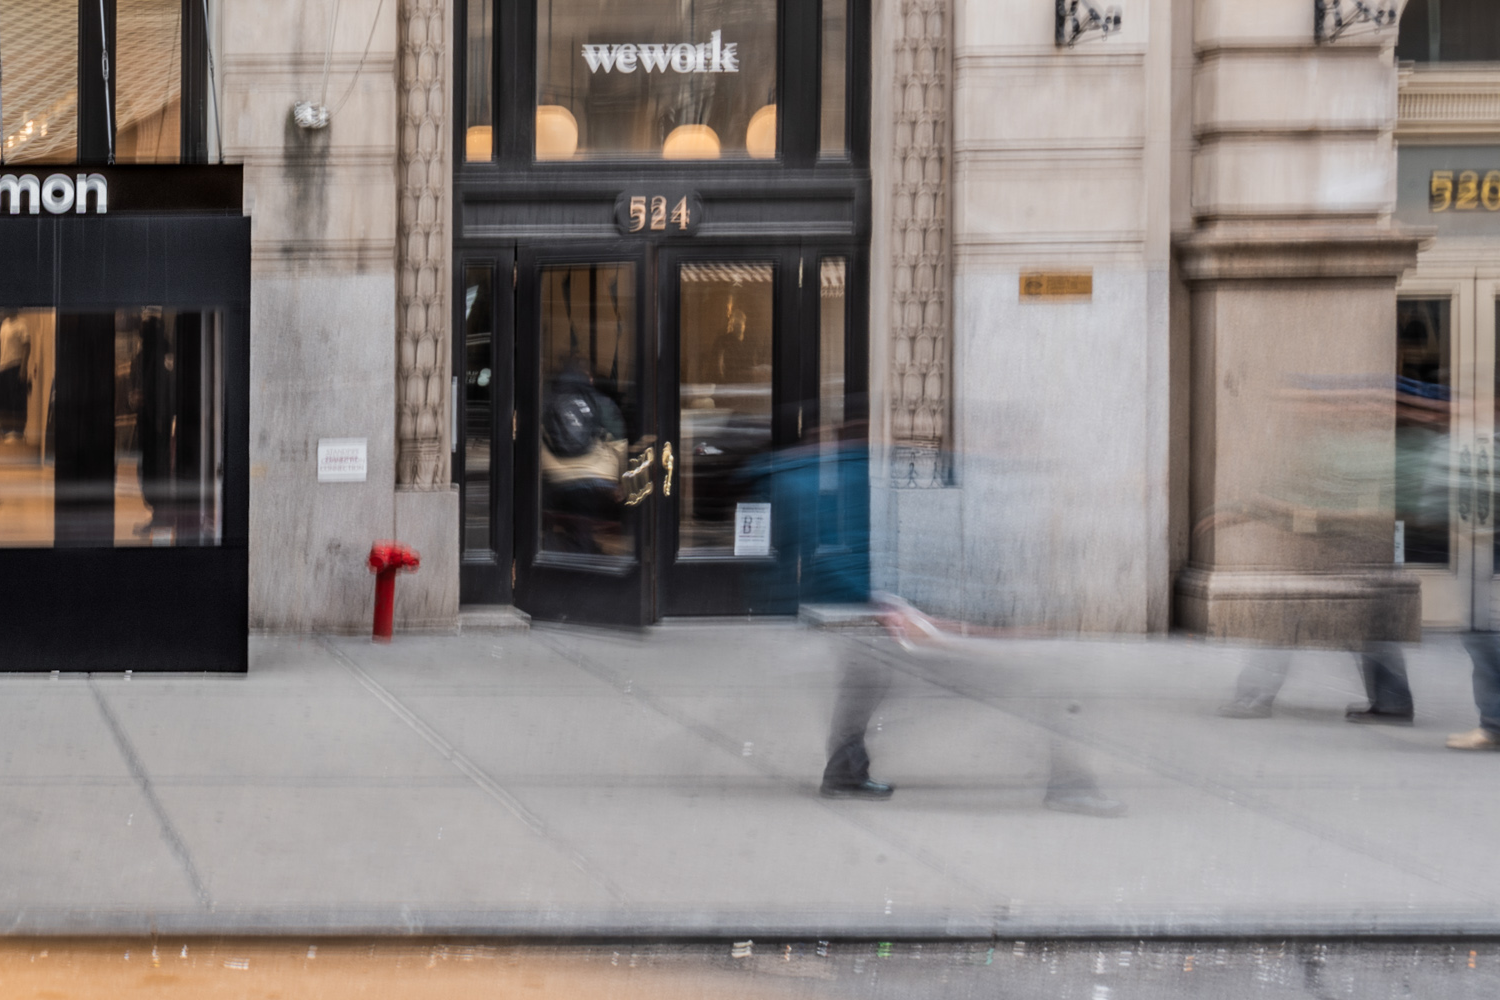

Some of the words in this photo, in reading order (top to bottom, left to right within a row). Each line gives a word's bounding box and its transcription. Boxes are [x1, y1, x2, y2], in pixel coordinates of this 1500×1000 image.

[581, 29, 740, 74] wework
[1431, 170, 1500, 212] 520
[629, 195, 691, 233] 524
